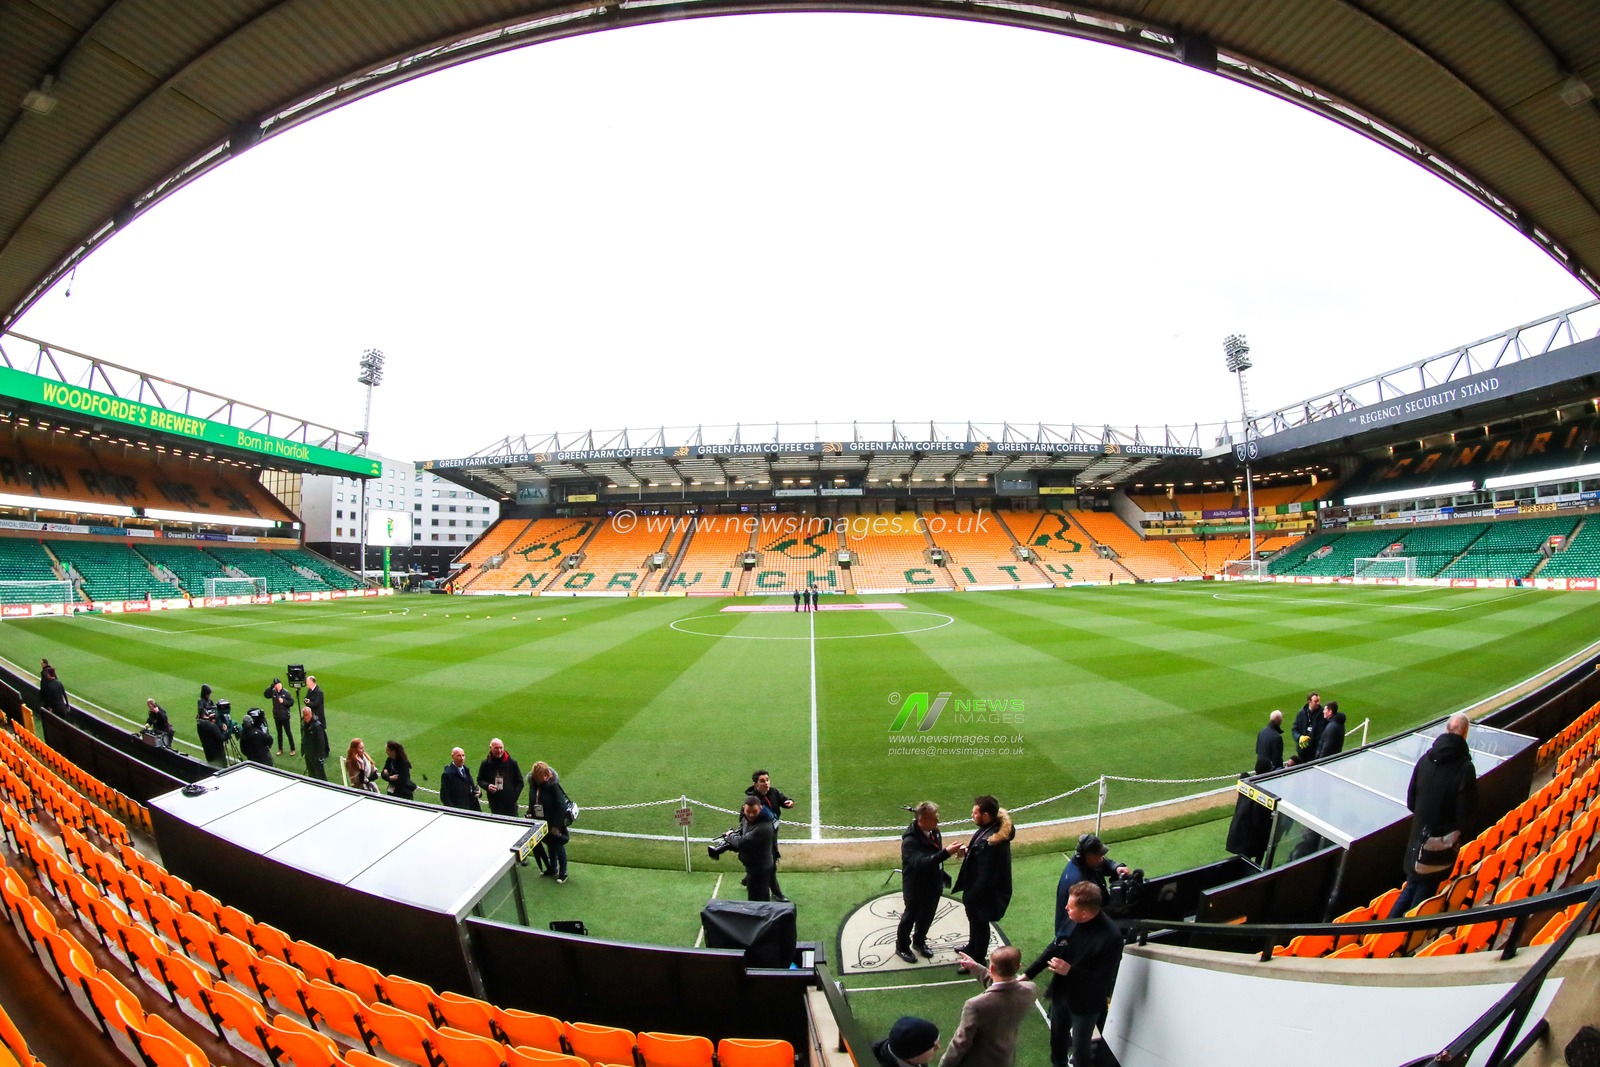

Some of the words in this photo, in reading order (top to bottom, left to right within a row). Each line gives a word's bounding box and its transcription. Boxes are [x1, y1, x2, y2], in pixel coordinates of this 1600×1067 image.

[1360, 405, 1402, 425] REGENCY
[1405, 389, 1457, 414] SECURITY
[1461, 377, 1500, 398] STAND
[44, 382, 147, 424] WOODFORDE'S
[150, 409, 206, 437] BREWERY
[238, 432, 262, 450] Born
[264, 436, 273, 452] in
[276, 441, 310, 460] Norfolk
[558, 452, 587, 460] GREEN
[590, 450, 614, 459] FARM
[616, 449, 652, 458] COFFEE
[698, 446, 731, 454] GREEN
[764, 444, 801, 452] COFFEE
[1126, 446, 1152, 454] GREEN
[1153, 446, 1174, 454] FARM
[1175, 447, 1200, 455] COFFEE
[440, 458, 464, 468] GREEN
[465, 458, 486, 466] FARM
[488, 456, 518, 464] COFFEE
[1521, 504, 1534, 512] PIPS
[1535, 503, 1553, 512] SKIPS
[513, 570, 836, 589] NORWICH
[904, 564, 1074, 585] CITY
